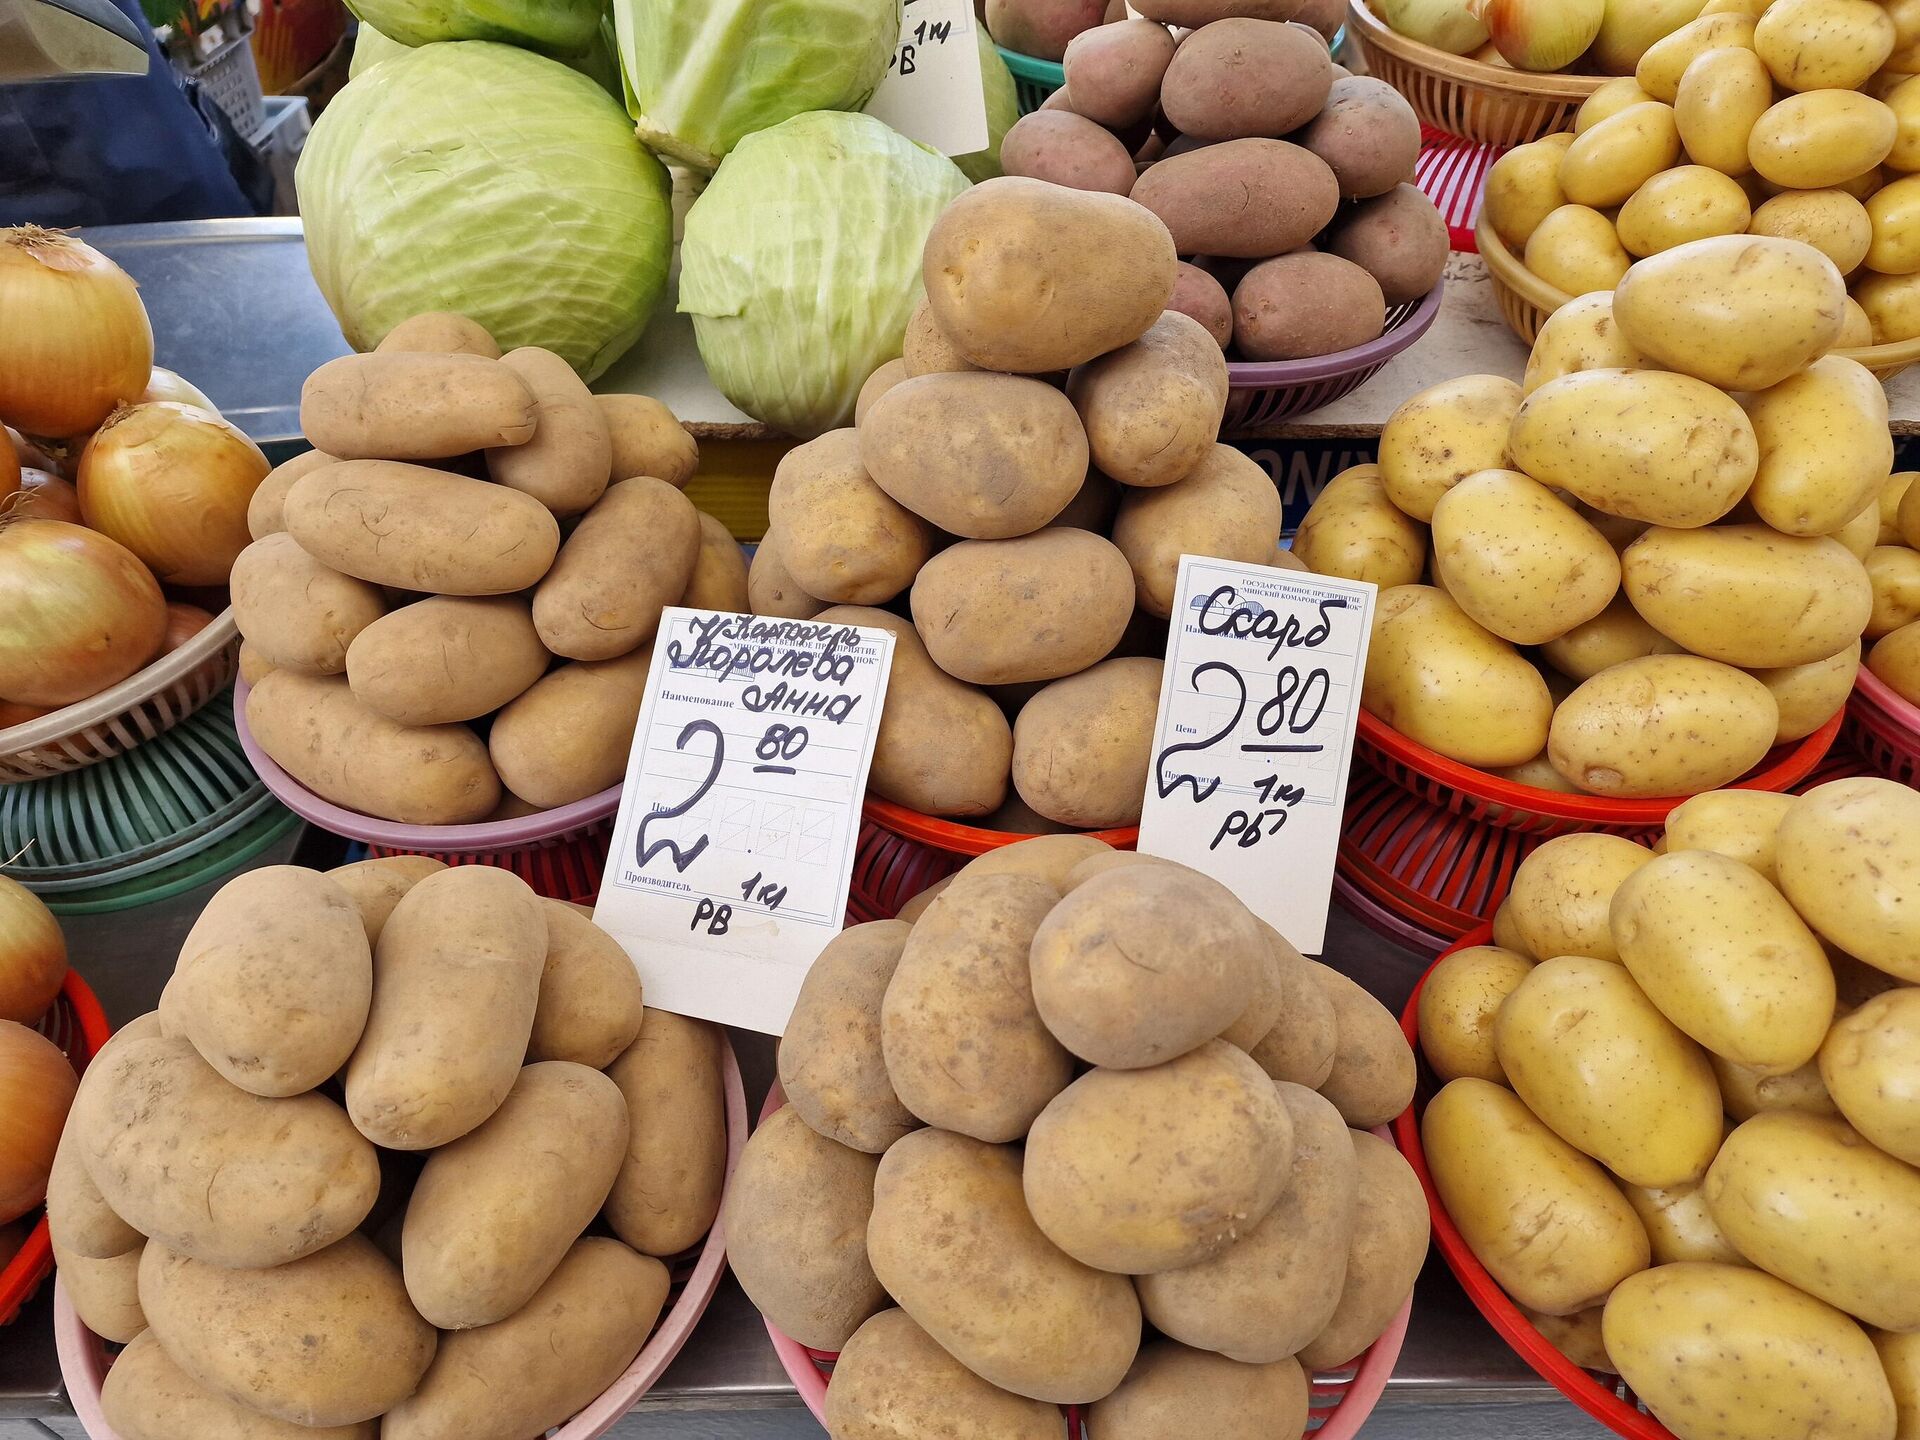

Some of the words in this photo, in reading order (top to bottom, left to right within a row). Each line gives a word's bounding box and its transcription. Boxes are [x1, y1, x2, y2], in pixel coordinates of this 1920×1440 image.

[1242, 579, 1311, 595] ГОСУДАРСТВЕННОЕ
[1199, 585, 1347, 661] Скарб
[815, 642, 878, 656] ПРПРИЯТИЕ
[661, 690, 735, 709] Наименование
[742, 681, 861, 725] Анна
[1156, 661, 1247, 803] 2
[1257, 666, 1330, 736] 80
[1175, 723, 1198, 735] Цена
[636, 719, 725, 873] 2
[755, 723, 809, 760] 80
[652, 801, 675, 814] Цен
[624, 870, 692, 892] Производитель
